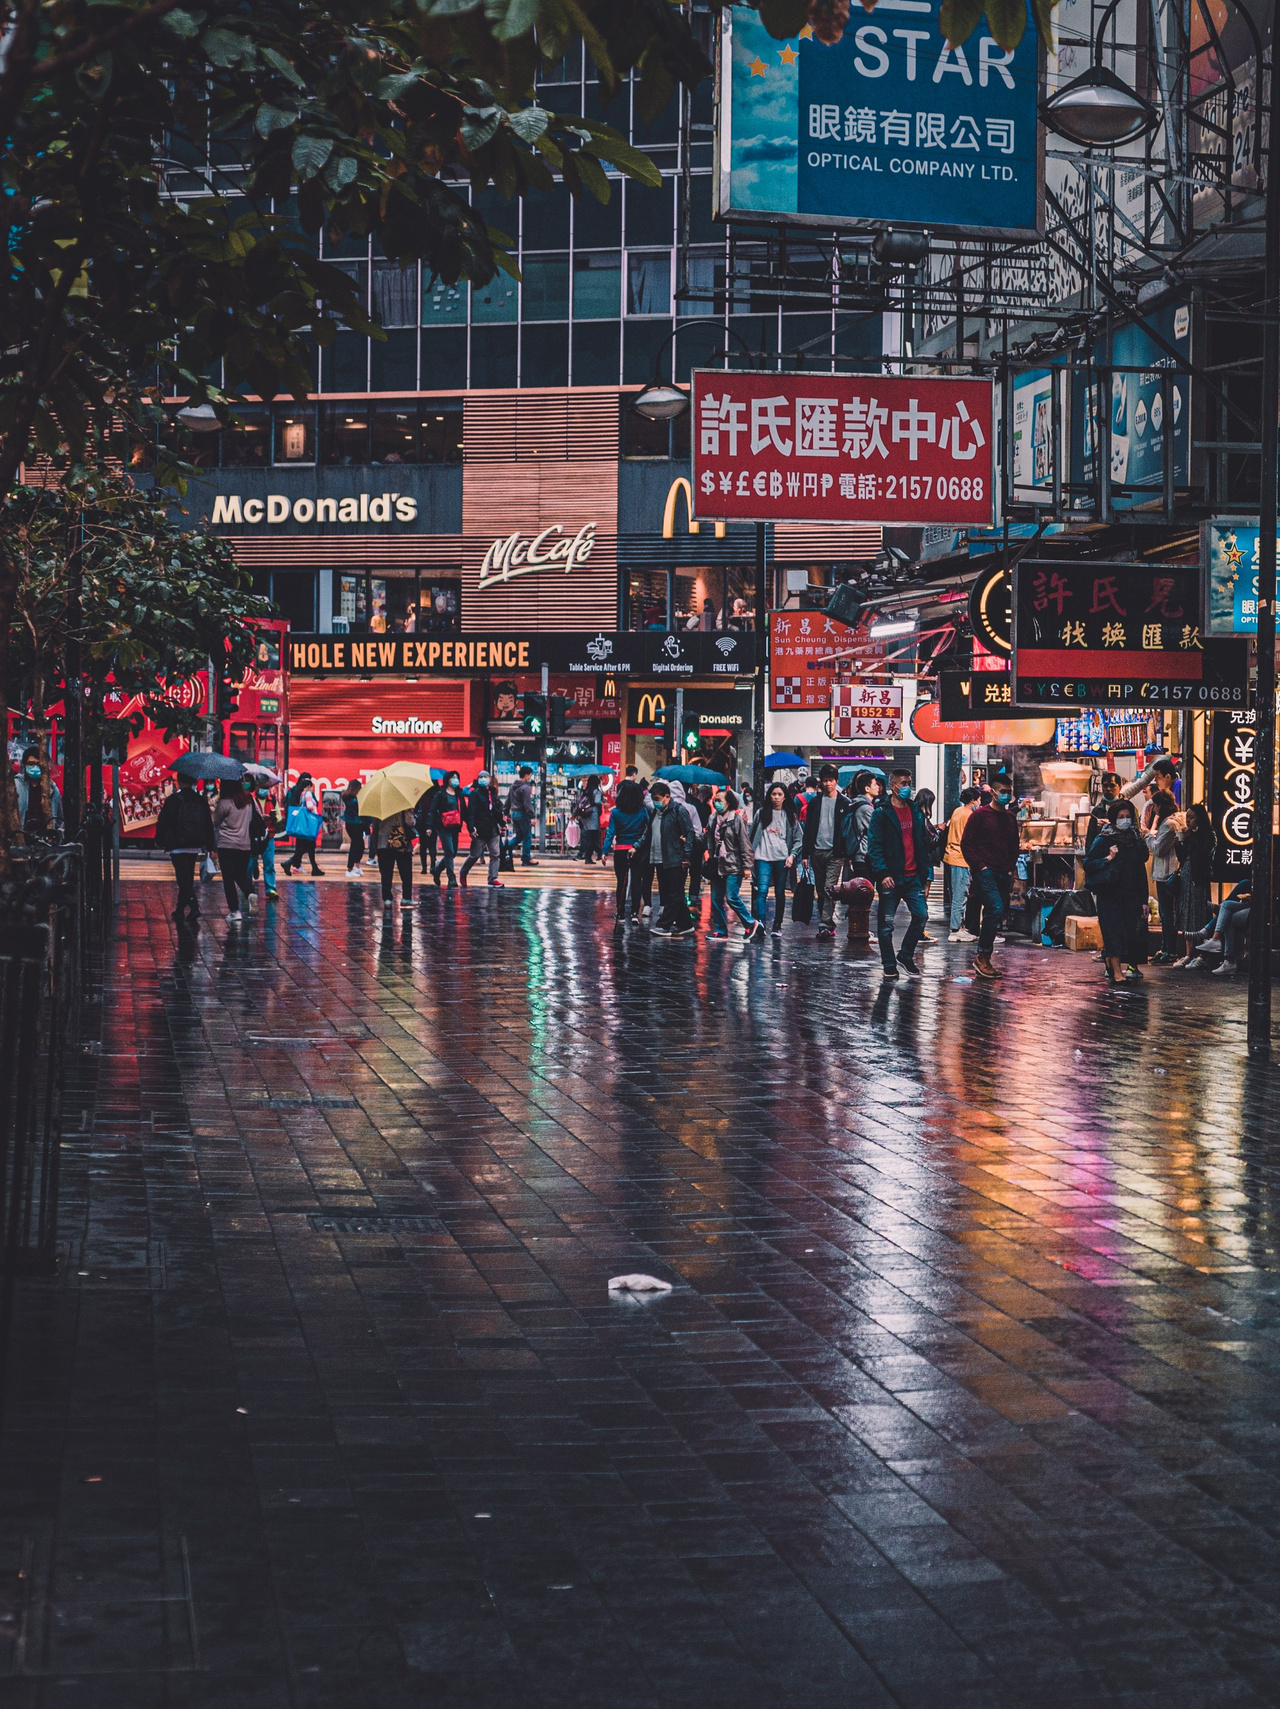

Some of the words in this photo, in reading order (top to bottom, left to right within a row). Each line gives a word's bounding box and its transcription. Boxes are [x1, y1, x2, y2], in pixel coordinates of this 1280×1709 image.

[854, 26, 1016, 89] STAR
[809, 104, 1015, 154] 眼鏡有限公司
[807, 151, 884, 172] OPTICAL
[889, 158, 975, 179] COMPANY
[981, 165, 1019, 182] LTD.
[700, 393, 986, 461] 許氏匯款中心
[212, 492, 418, 523] McDonald's
[480, 522, 598, 582] McCafé
[794, 636, 827, 644] Cheung
[1061, 620, 1205, 649] 找換匯款
[289, 643, 345, 668] HOLE
[352, 642, 396, 668] NEW
[403, 641, 530, 668] EXPERIENCE
[569, 663, 583, 672] Table
[583, 663, 602, 672] Service
[603, 663, 617, 672] After
[621, 663, 631, 672] PM
[652, 663, 671, 673] Digital
[671, 663, 693, 673] Ordering
[713, 663, 726, 672] FREE
[858, 688, 892, 706] 新昌
[1149, 684, 1193, 700] 2157
[1199, 685, 1242, 701] 0688
[371, 716, 443, 734] SmarTone
[855, 720, 900, 736] 大藥房
[1226, 849, 1253, 865] 汇款
